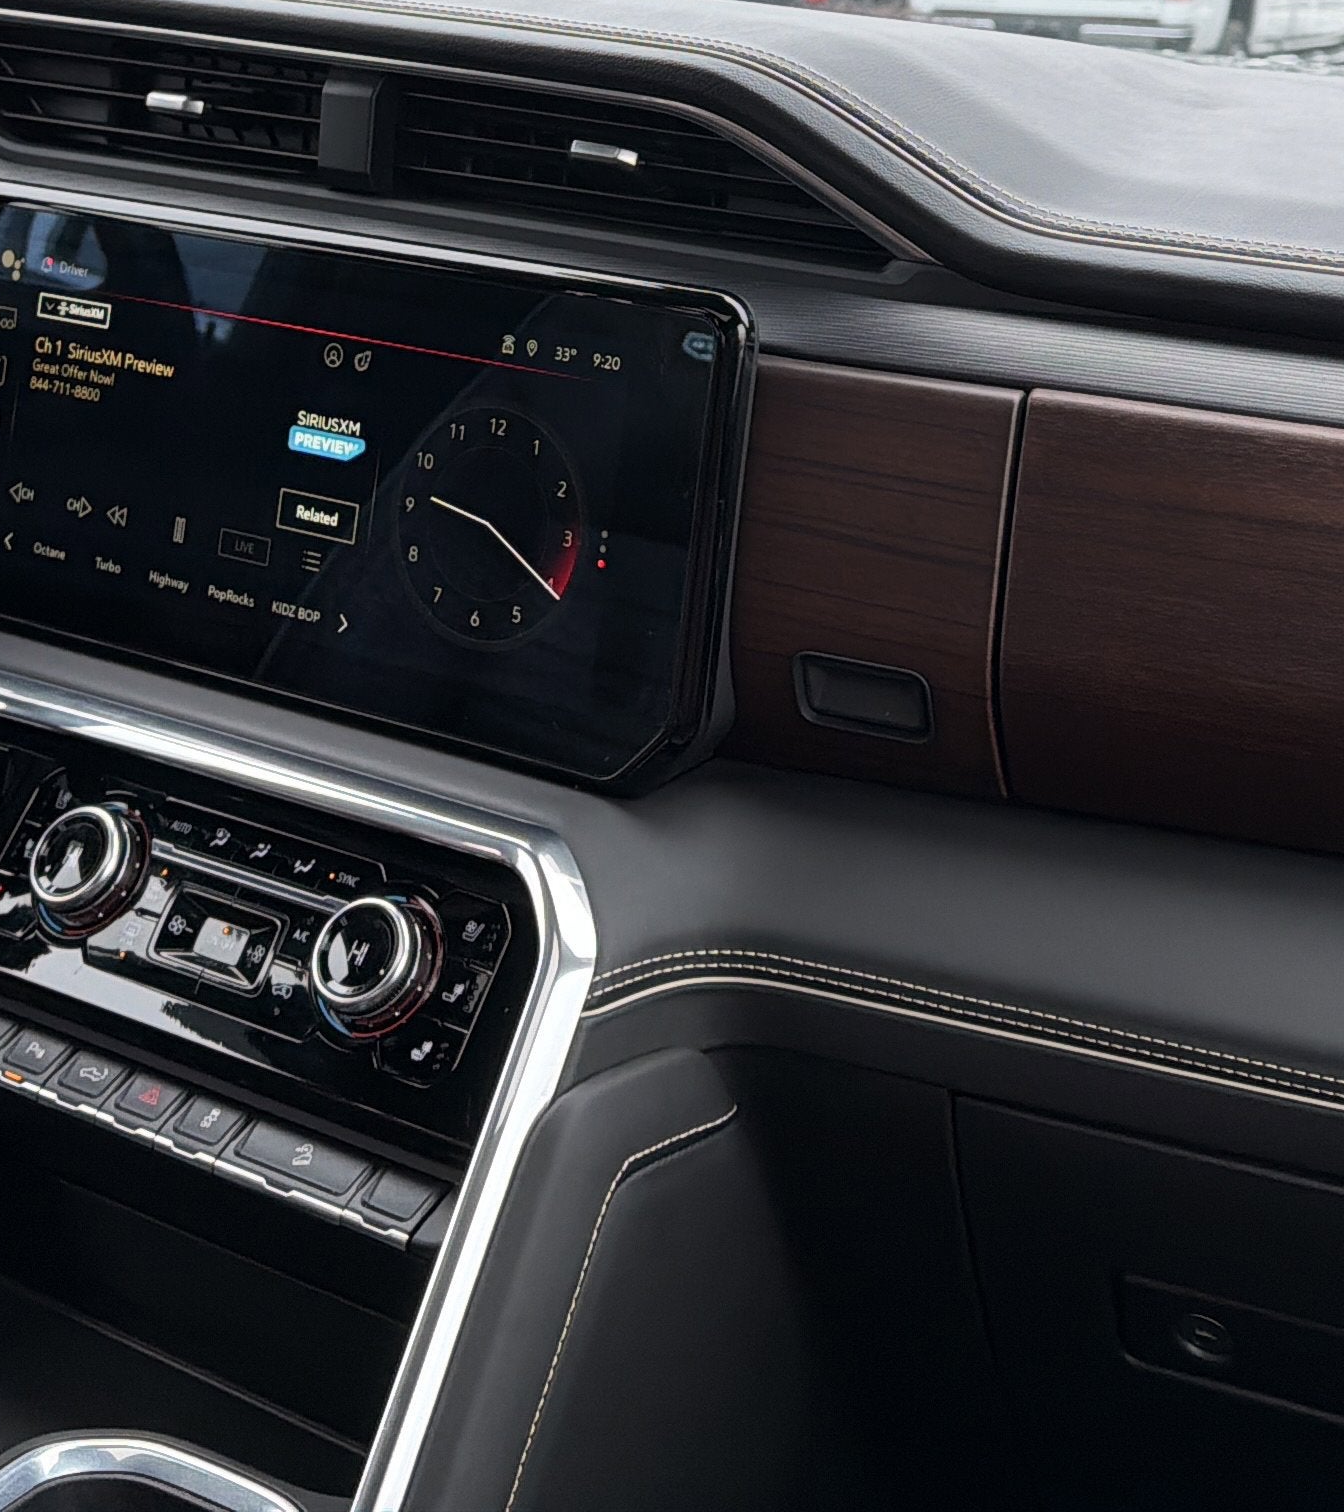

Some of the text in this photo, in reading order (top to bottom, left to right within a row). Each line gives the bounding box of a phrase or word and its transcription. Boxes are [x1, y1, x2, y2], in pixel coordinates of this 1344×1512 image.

[59, 260, 89, 277] Driver
[68, 303, 105, 320] SiriusXM
[34, 336, 176, 378] Ch 1 SiriusXM Preview
[554, 346, 578, 363] 33°
[592, 352, 622, 372] 9:20
[32, 357, 116, 387] Great Offer Now!
[29, 375, 101, 403] 844-711-8800
[297, 409, 361, 436] SIRIUSXM
[489, 417, 508, 437] 12
[449, 423, 466, 442] 11
[294, 432, 357, 456] PREVIEW
[532, 438, 540, 456] 1
[416, 451, 434, 470] 10
[21, 487, 35, 502] CH
[555, 479, 568, 499] 2
[66, 497, 82, 512] CH
[405, 496, 416, 513] 9
[295, 504, 340, 528] Related
[234, 539, 255, 555] LIVE
[561, 529, 573, 549] 3
[32, 541, 66, 561] Octane
[407, 545, 419, 563] 8
[95, 556, 122, 576] Turbo
[148, 569, 190, 594] Highway
[206, 584, 255, 609] PopRocks
[432, 587, 443, 603] 7
[270, 600, 322, 624] KIDZ BOP
[469, 609, 481, 628] 6
[511, 606, 522, 624] 5
[170, 821, 193, 835] AUTO
[336, 871, 361, 888] SYNC
